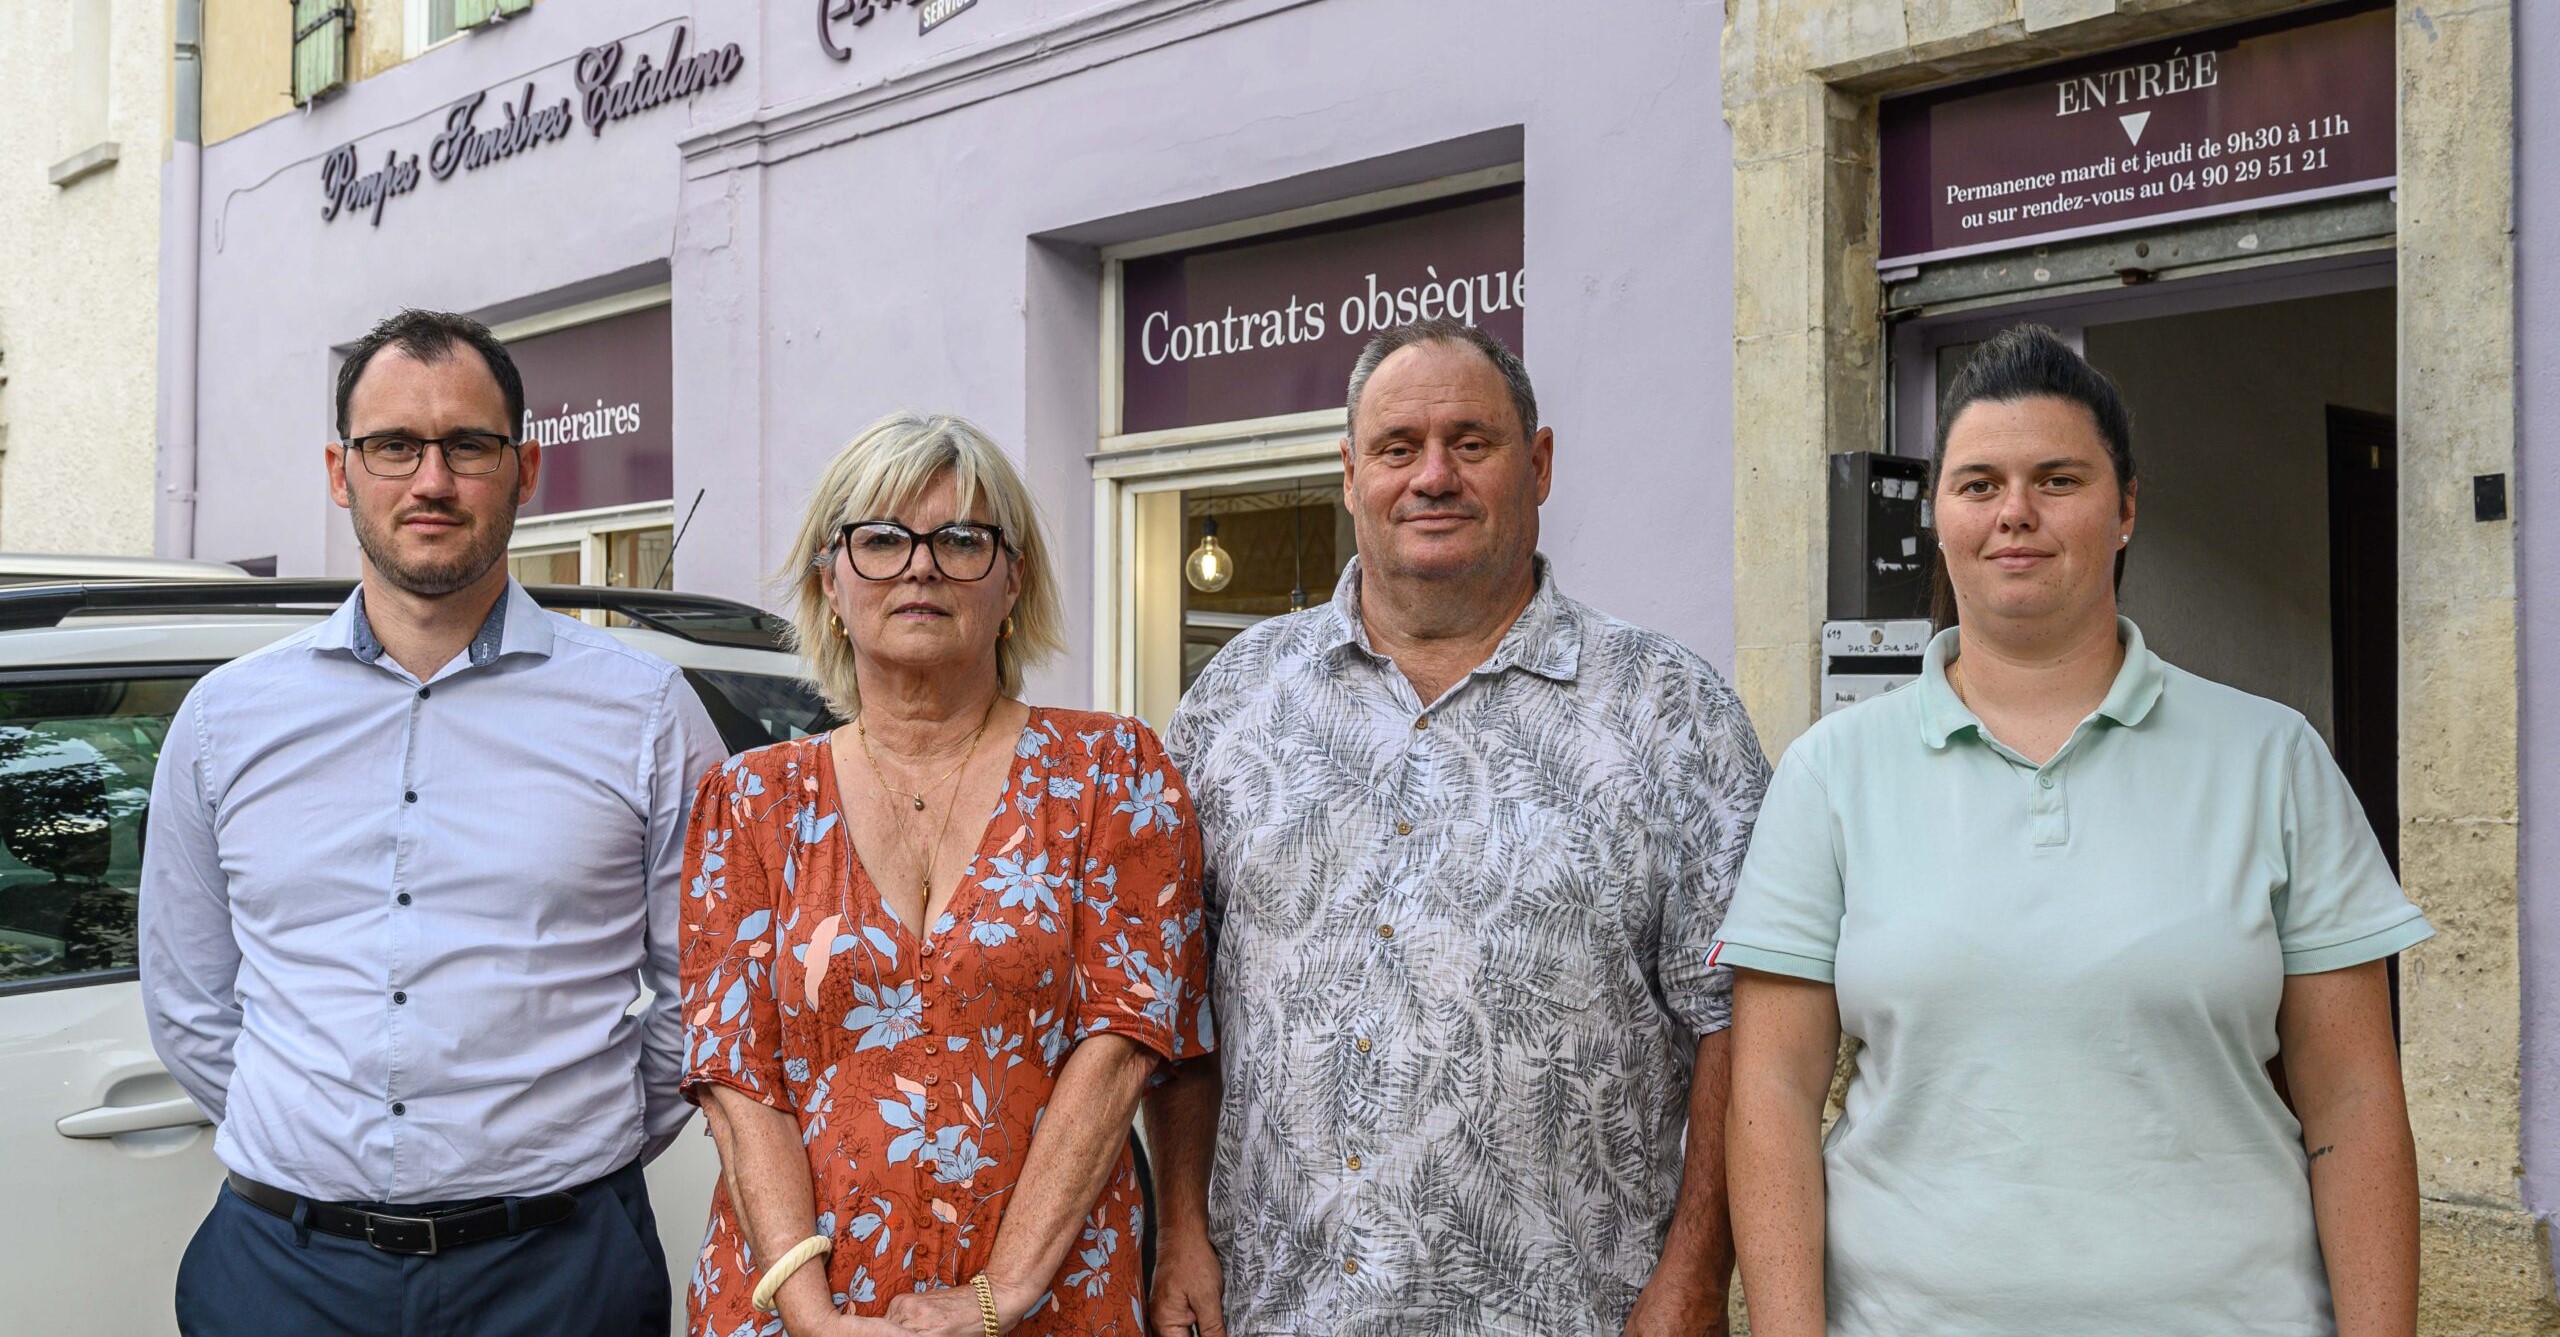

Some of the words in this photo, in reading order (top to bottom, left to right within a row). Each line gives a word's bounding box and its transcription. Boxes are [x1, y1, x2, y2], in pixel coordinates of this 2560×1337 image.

[2056, 46, 2219, 117] ENTRÉE
[321, 143, 420, 227] Pompes
[429, 81, 573, 182] Funèbres
[574, 25, 745, 137] Catalano
[1946, 172, 2057, 205] Permanence
[2060, 155, 2117, 184] mardi
[2120, 154, 2140, 174] et
[2142, 142, 2193, 175] jeudi
[2198, 137, 2222, 160] de
[2227, 125, 2282, 154] 9h30
[2288, 122, 2301, 144] à
[2309, 114, 2350, 140] 11h
[1961, 213, 1984, 229] ou
[1987, 206, 2018, 224] sur
[2022, 187, 2135, 219] rendez-vous
[2139, 181, 2164, 199] au
[2169, 170, 2196, 193] 04
[2201, 164, 2229, 188] 90
[2234, 158, 2262, 183] 29
[2268, 153, 2293, 177] 51
[2302, 147, 2327, 171] 21
[1142, 294, 1326, 366] Contrats
[522, 398, 641, 448] funéraires
[1848, 644, 1865, 653] PAS
[1868, 644, 1880, 653] DE
